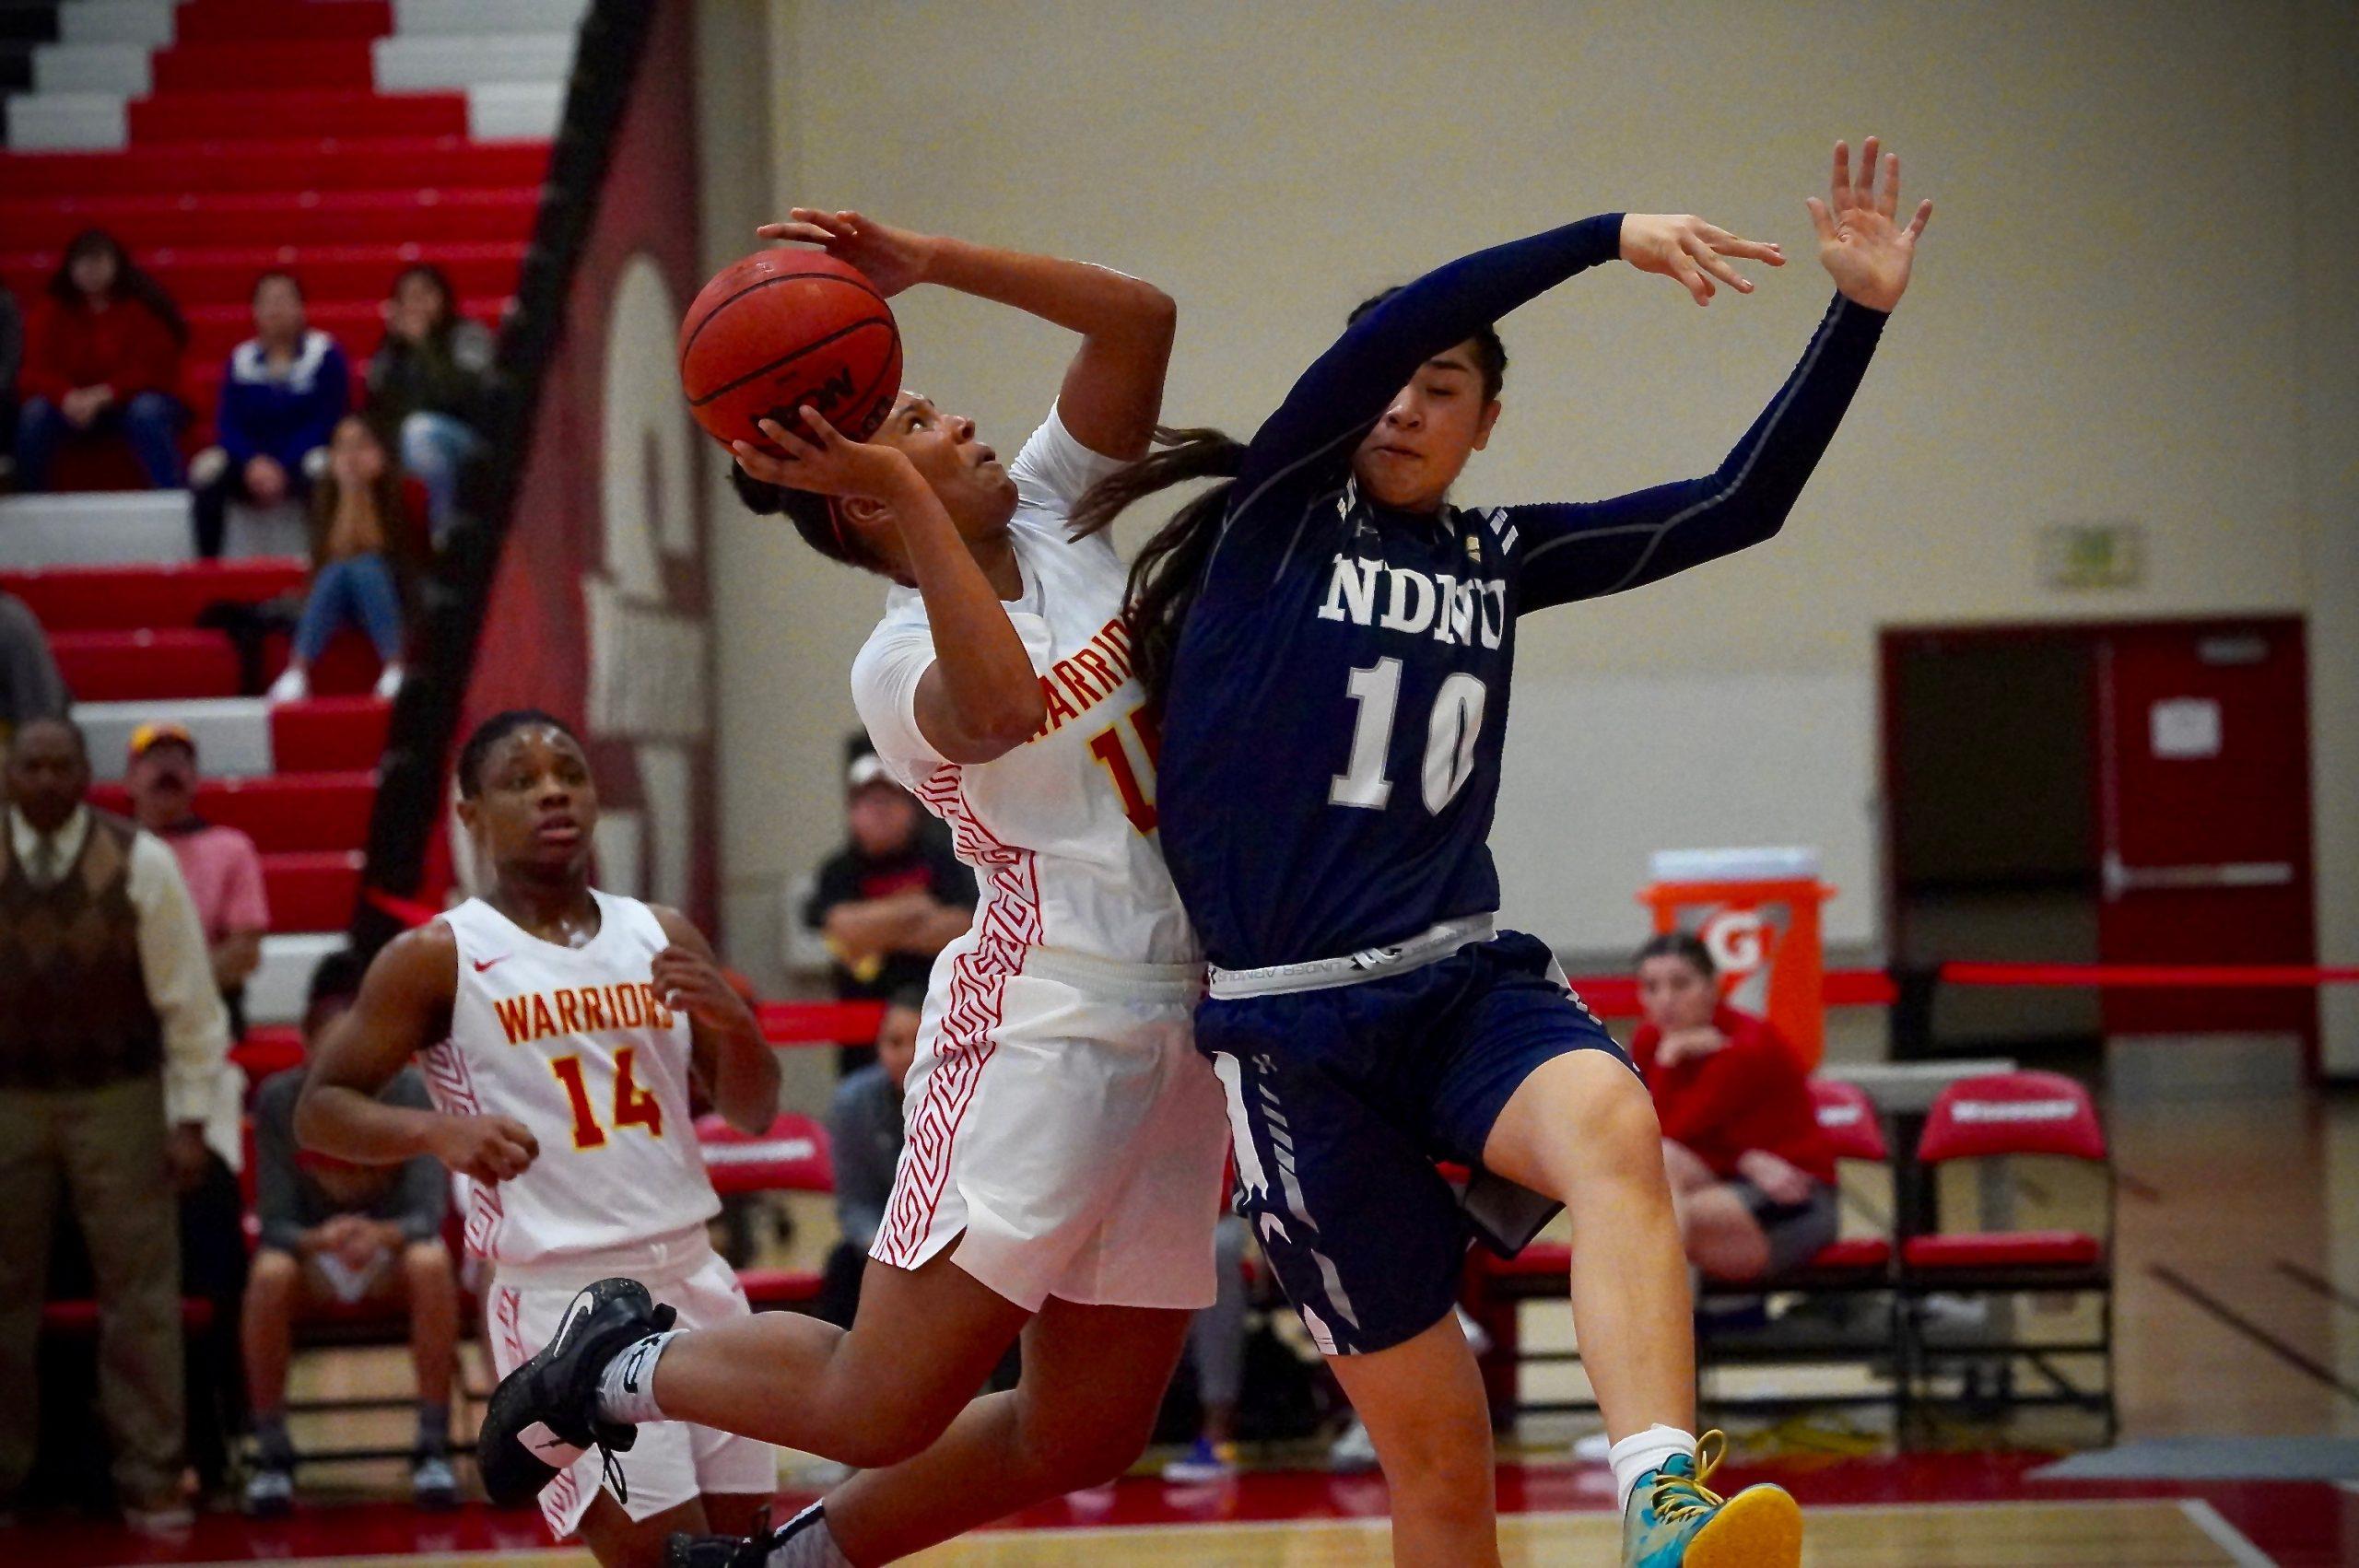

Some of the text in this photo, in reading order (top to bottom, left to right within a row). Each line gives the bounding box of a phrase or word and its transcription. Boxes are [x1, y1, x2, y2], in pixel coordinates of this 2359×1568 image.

[1318, 554, 1506, 650] NDNU
[1328, 656, 1486, 817] 10
[1708, 911, 1761, 970] G
[551, 1047, 663, 1152] 14
